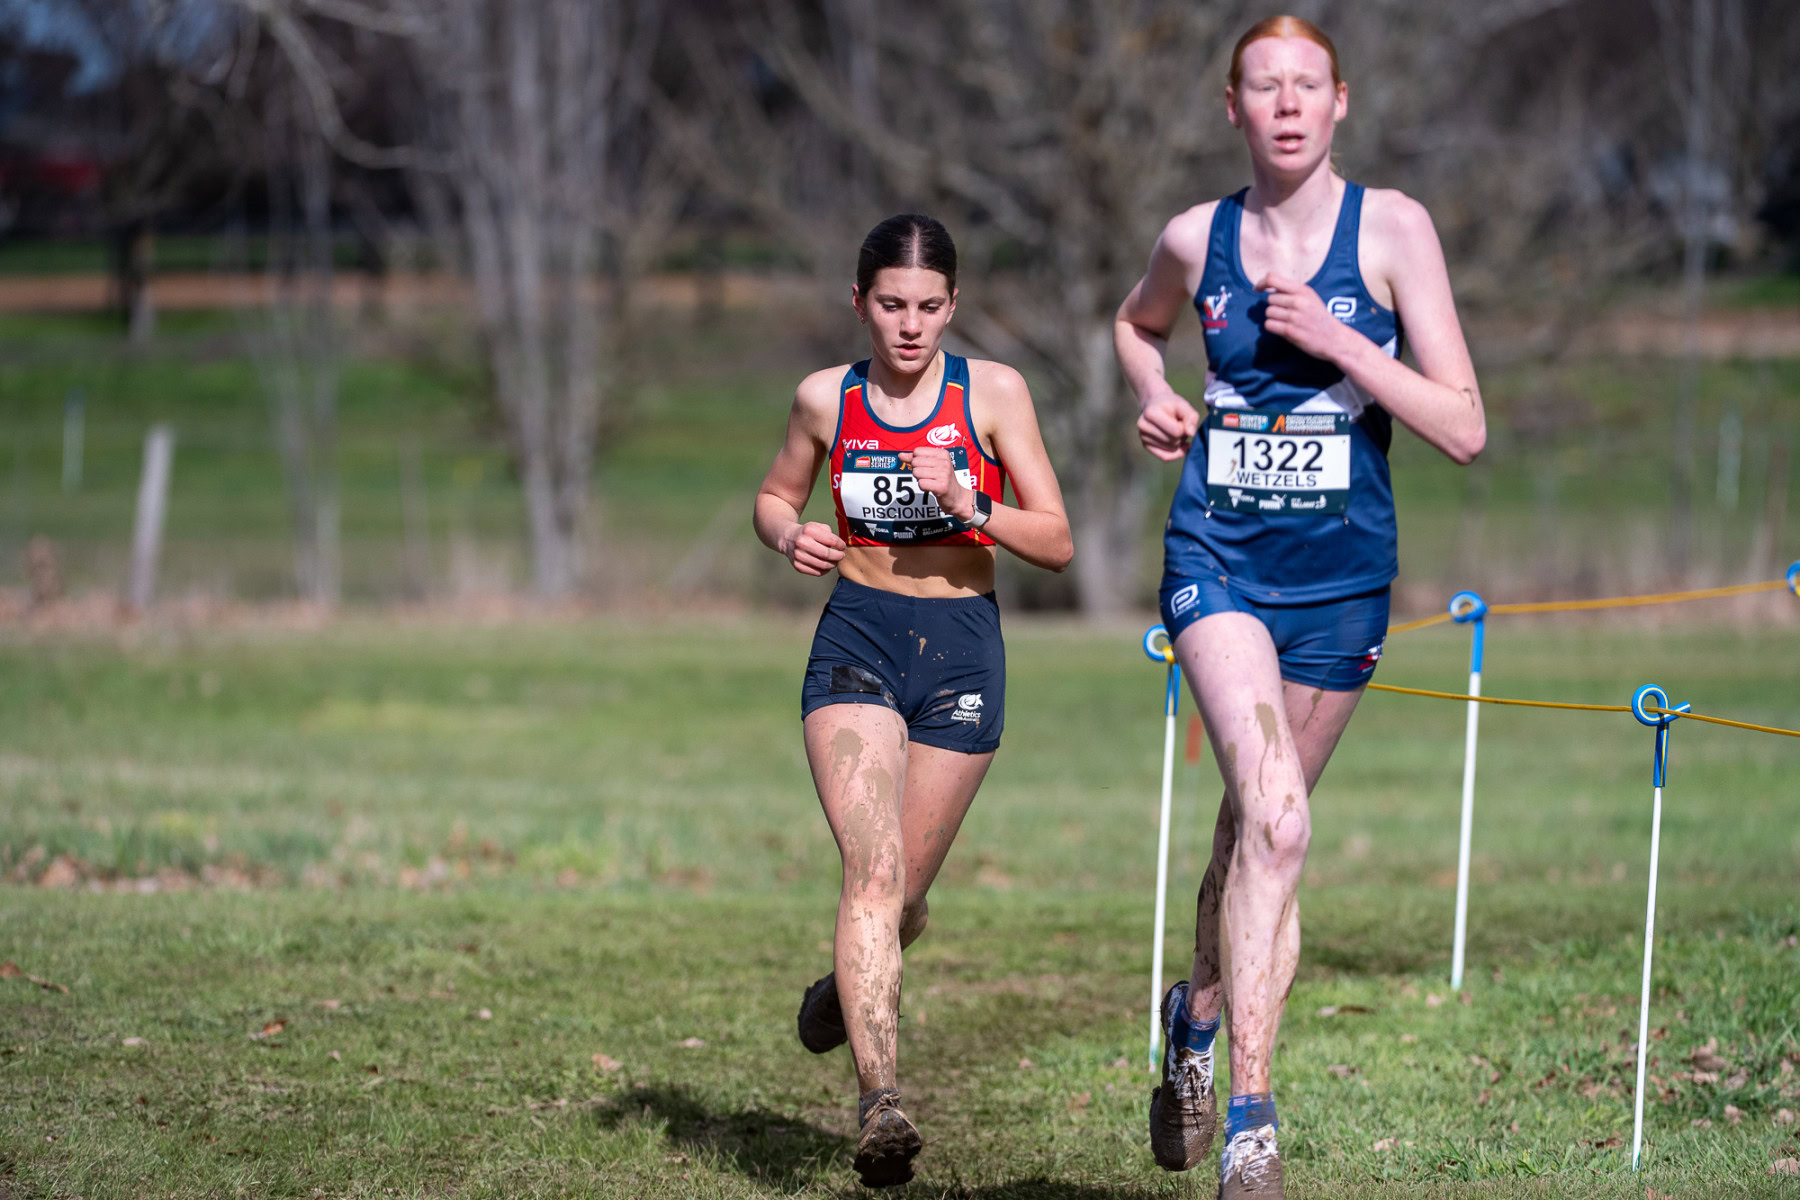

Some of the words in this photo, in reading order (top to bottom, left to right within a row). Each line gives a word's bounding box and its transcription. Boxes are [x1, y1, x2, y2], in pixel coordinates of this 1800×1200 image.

[871, 455, 896, 463] WINTER
[1233, 436, 1323, 472] 1322
[1237, 471, 1317, 488] WETZELS
[862, 506, 941, 519] PISCIONE
[893, 531, 913, 539] PUMA
